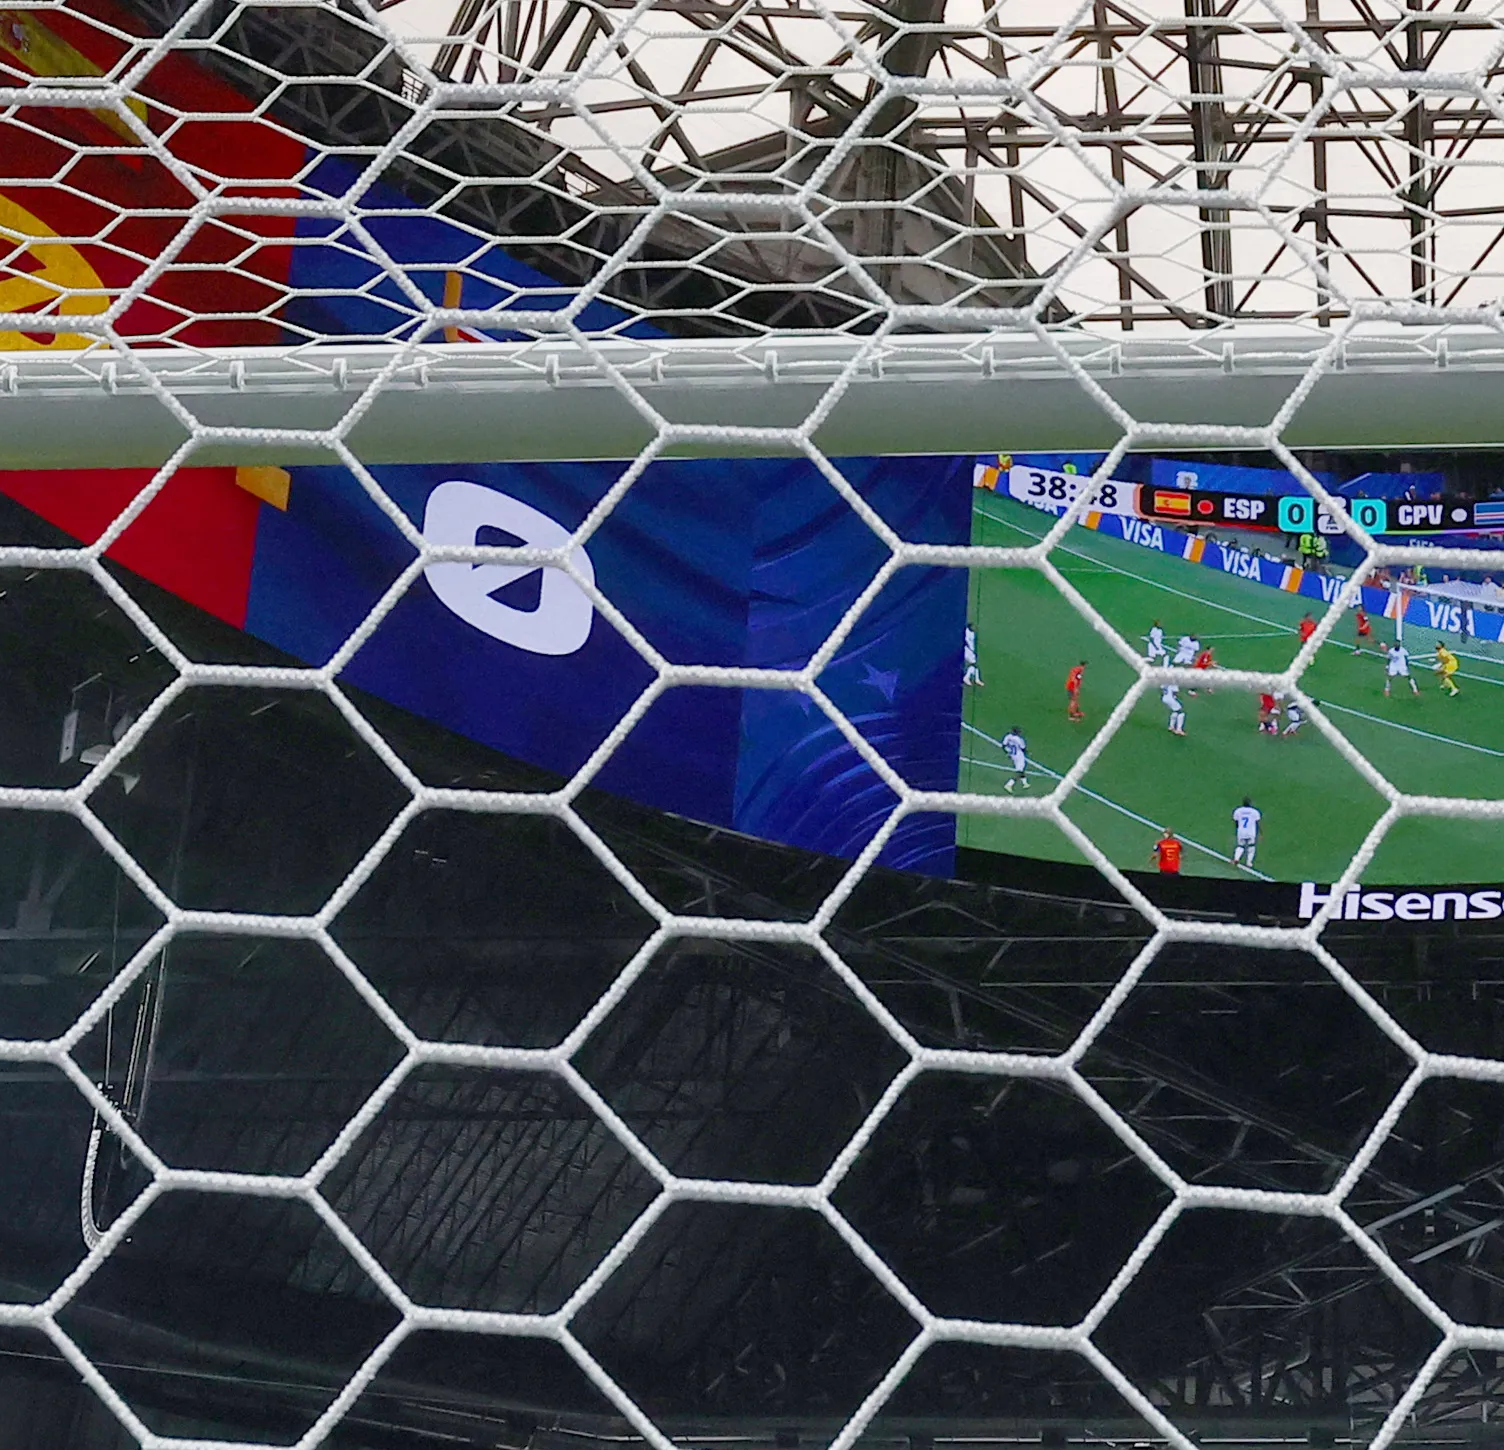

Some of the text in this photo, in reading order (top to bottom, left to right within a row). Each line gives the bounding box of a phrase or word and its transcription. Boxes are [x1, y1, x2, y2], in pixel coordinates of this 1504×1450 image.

[1028, 472, 1117, 508] 38:8
[1223, 498, 1305, 525] ESP 0
[1360, 504, 1443, 526] 0 CPV
[1119, 516, 1164, 551] VISA
[1219, 545, 1261, 581] VISA
[1425, 600, 1476, 636] VISA
